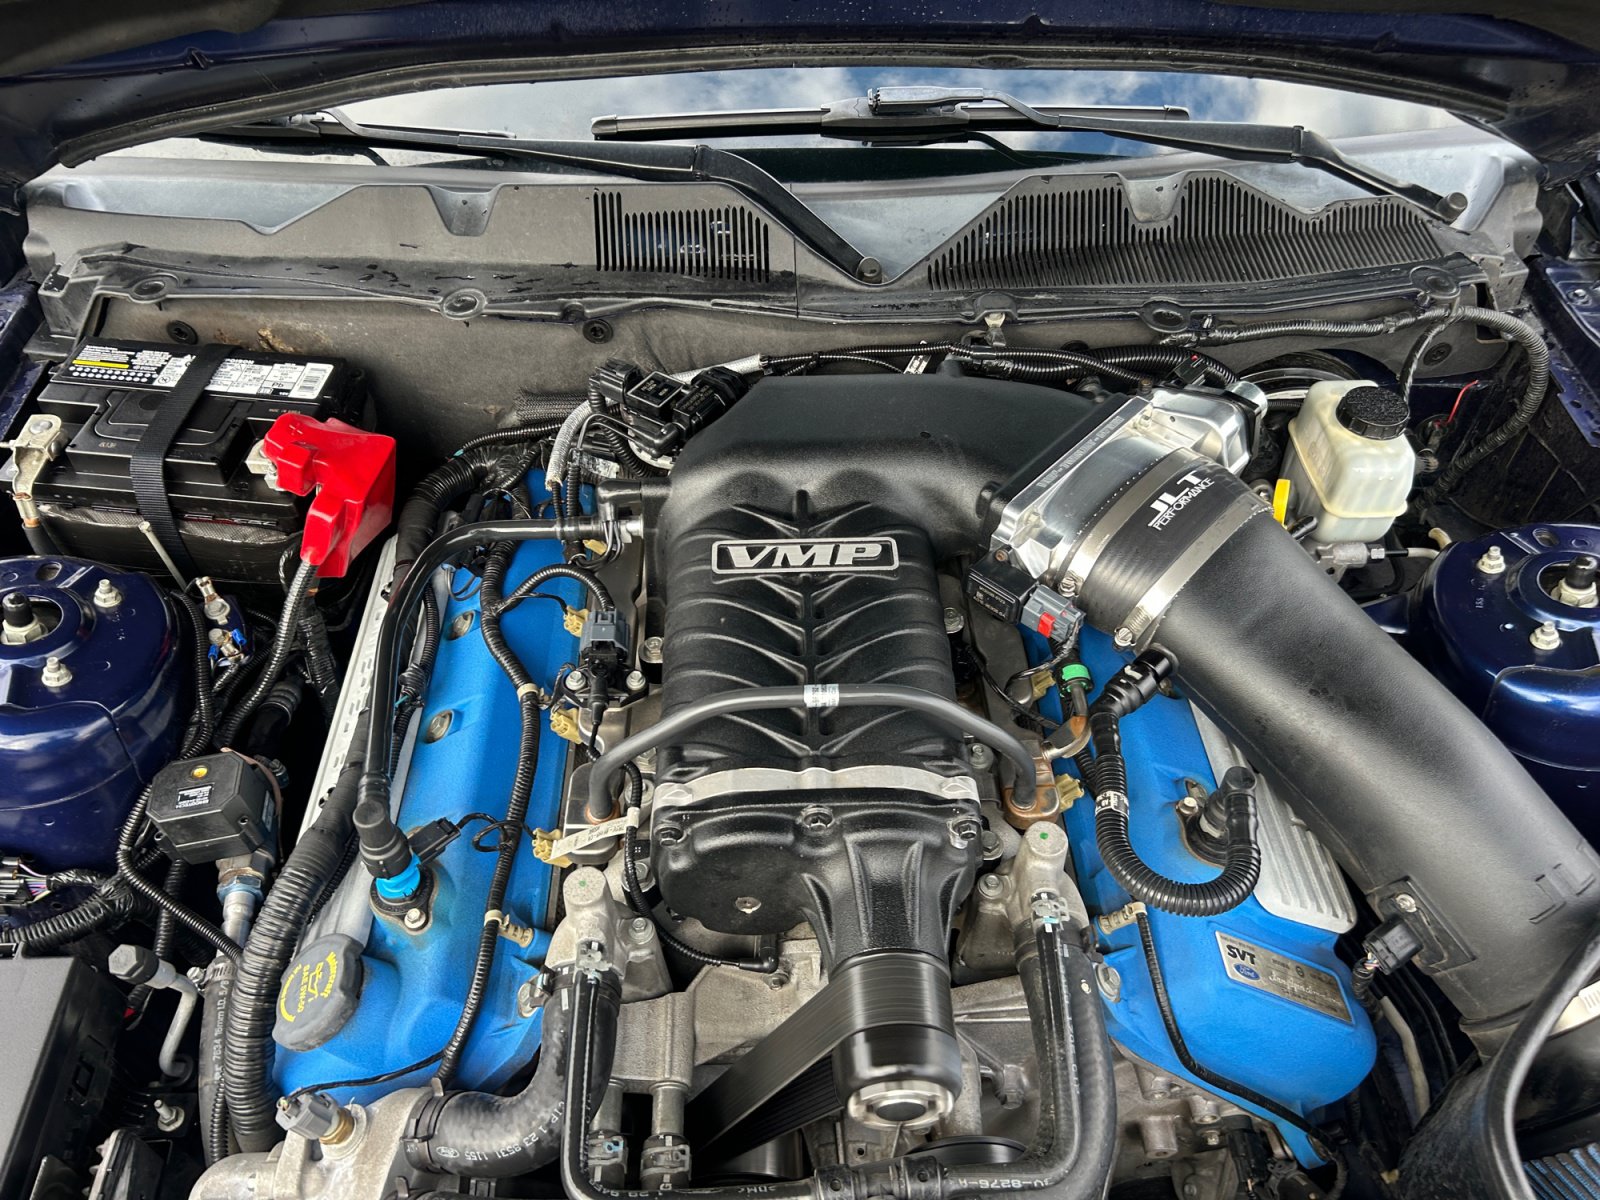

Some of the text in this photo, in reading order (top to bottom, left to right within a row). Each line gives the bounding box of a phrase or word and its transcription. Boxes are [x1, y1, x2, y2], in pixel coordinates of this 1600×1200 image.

[1148, 470, 1202, 527] JLT
[1152, 477, 1215, 531] PERFORMANCE
[727, 543, 882, 568] VMP
[1226, 944, 1256, 965] SVT
[522, 1132, 539, 1147] 23
